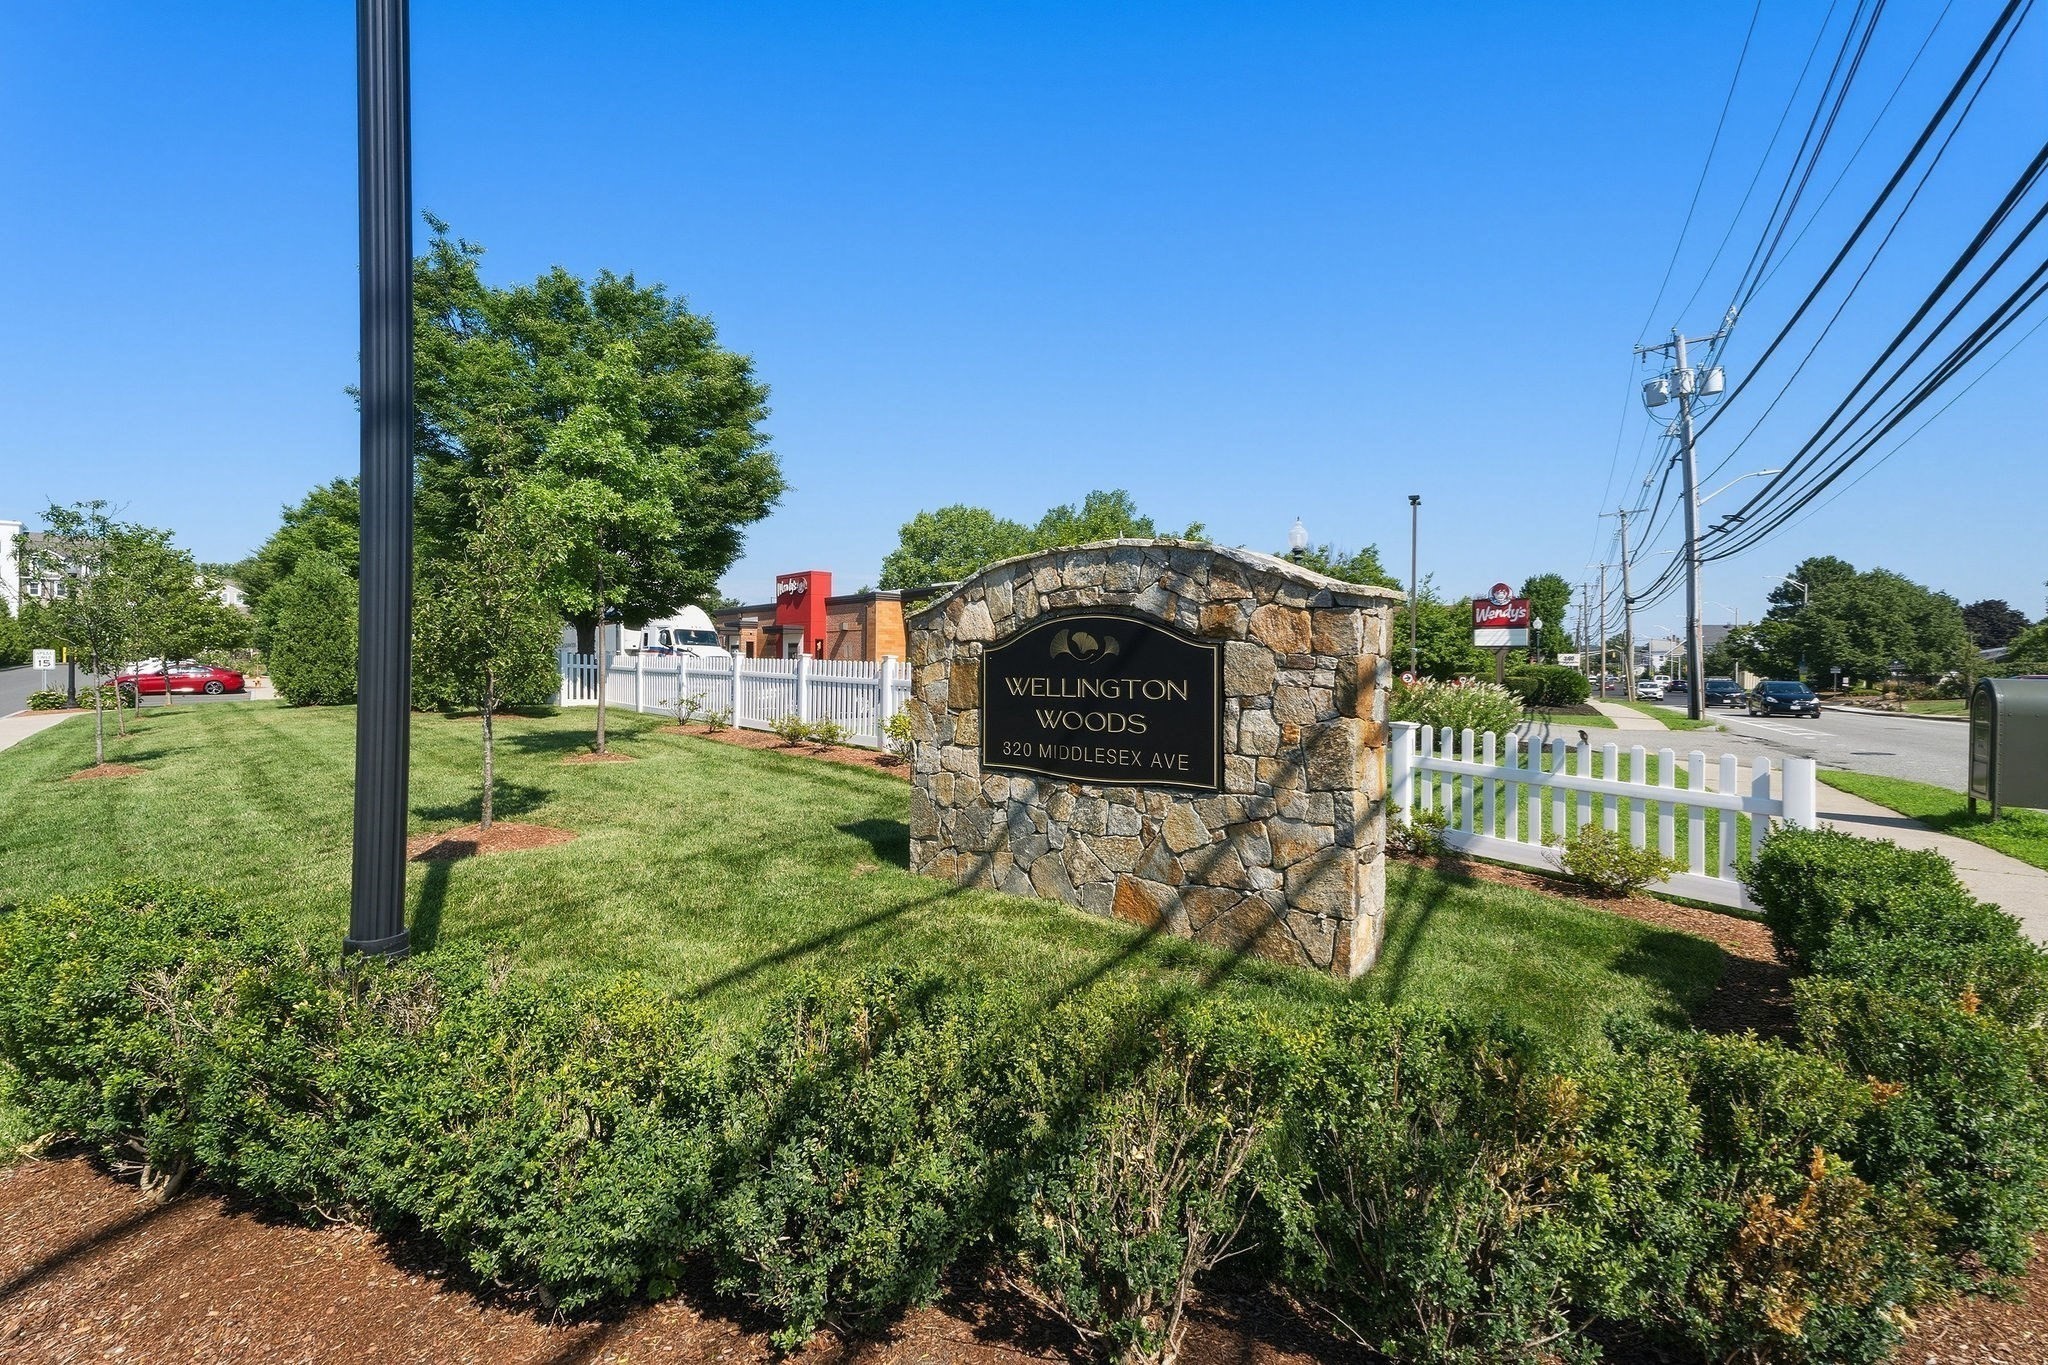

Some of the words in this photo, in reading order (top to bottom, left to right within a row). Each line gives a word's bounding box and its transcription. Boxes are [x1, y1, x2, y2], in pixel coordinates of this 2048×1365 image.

[1475, 603, 1527, 623] Wendy's
[38, 659, 52, 667] 15
[1004, 676, 1188, 701] WELLINGTON
[1035, 709, 1148, 734] WOODS
[1002, 741, 1032, 757] 320
[1039, 743, 1142, 767] MIDDLESEX
[1150, 752, 1190, 771] AVE
